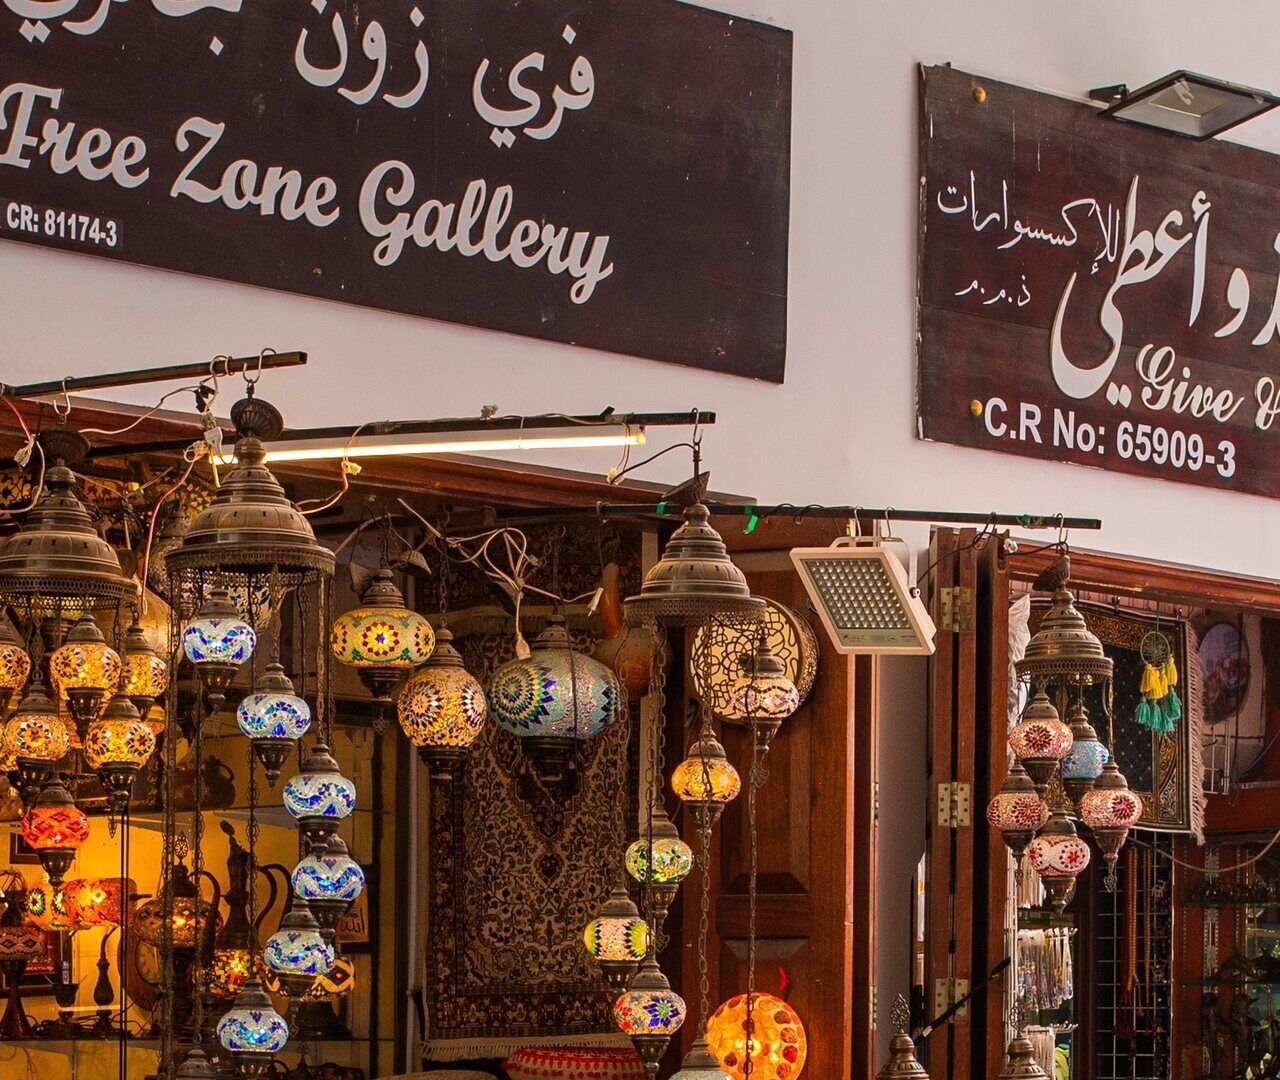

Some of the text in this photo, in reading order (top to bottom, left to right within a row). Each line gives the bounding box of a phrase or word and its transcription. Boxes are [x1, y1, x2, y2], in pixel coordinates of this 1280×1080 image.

[295, 0, 429, 108] زون
[472, 25, 594, 148] فري
[6, 201, 117, 247] CR: 81174-3
[170, 116, 340, 227] Zone
[359, 160, 613, 304] Gallery
[1136, 343, 1245, 423] Give
[984, 397, 1236, 479] C.R No: 65909-3
